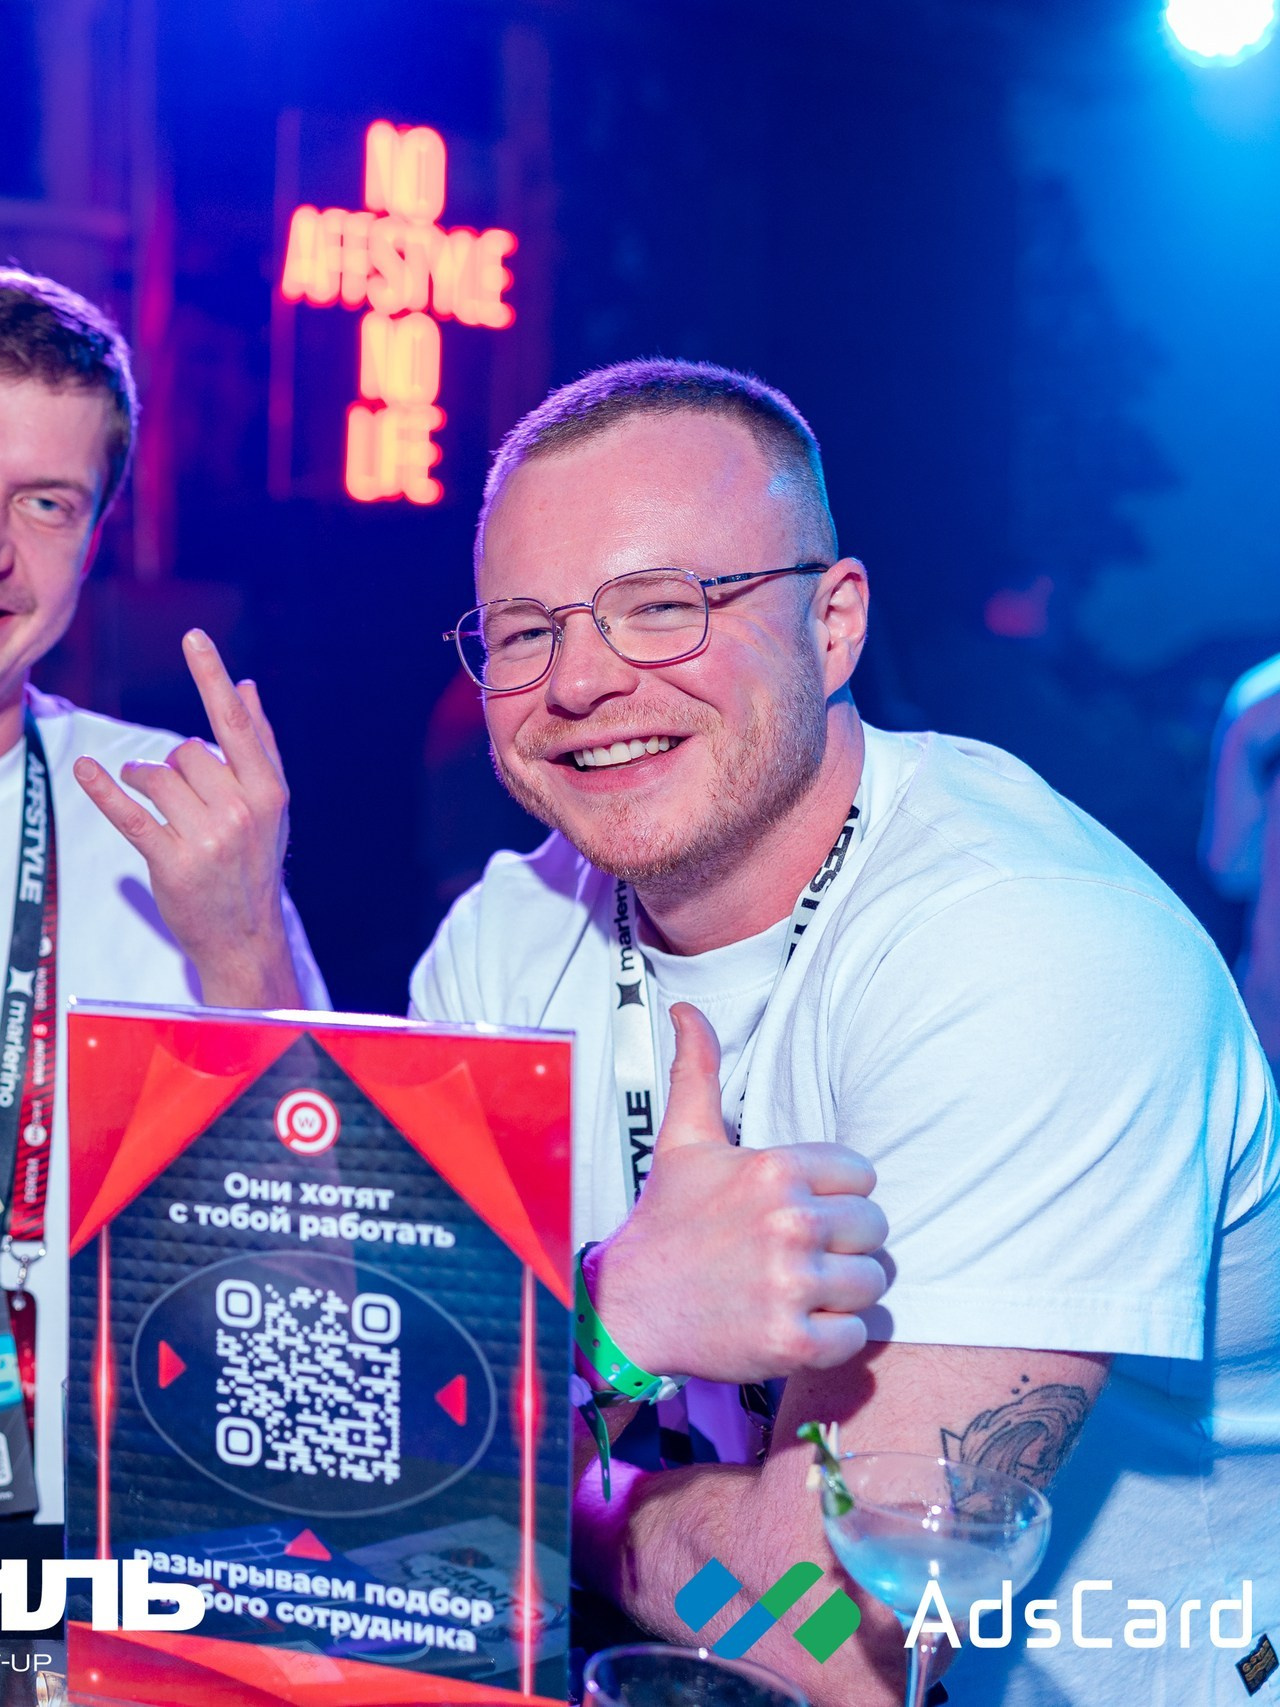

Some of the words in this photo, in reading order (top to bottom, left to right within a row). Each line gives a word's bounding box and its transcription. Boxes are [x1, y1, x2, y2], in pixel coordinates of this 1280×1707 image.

[364, 118, 447, 224] NO
[358, 310, 443, 408] NO
[19, 752, 48, 905] AFFSTYLE
[626, 1089, 654, 1203] TYLE
[168, 1203, 189, 1225] с
[194, 1201, 291, 1234] тобой
[298, 1212, 456, 1249] работать
[224, 1171, 291, 1203] Они
[300, 1181, 395, 1210] хотят
[275, 1600, 477, 1653] сотрудника
[364, 1582, 495, 1627] подбор
